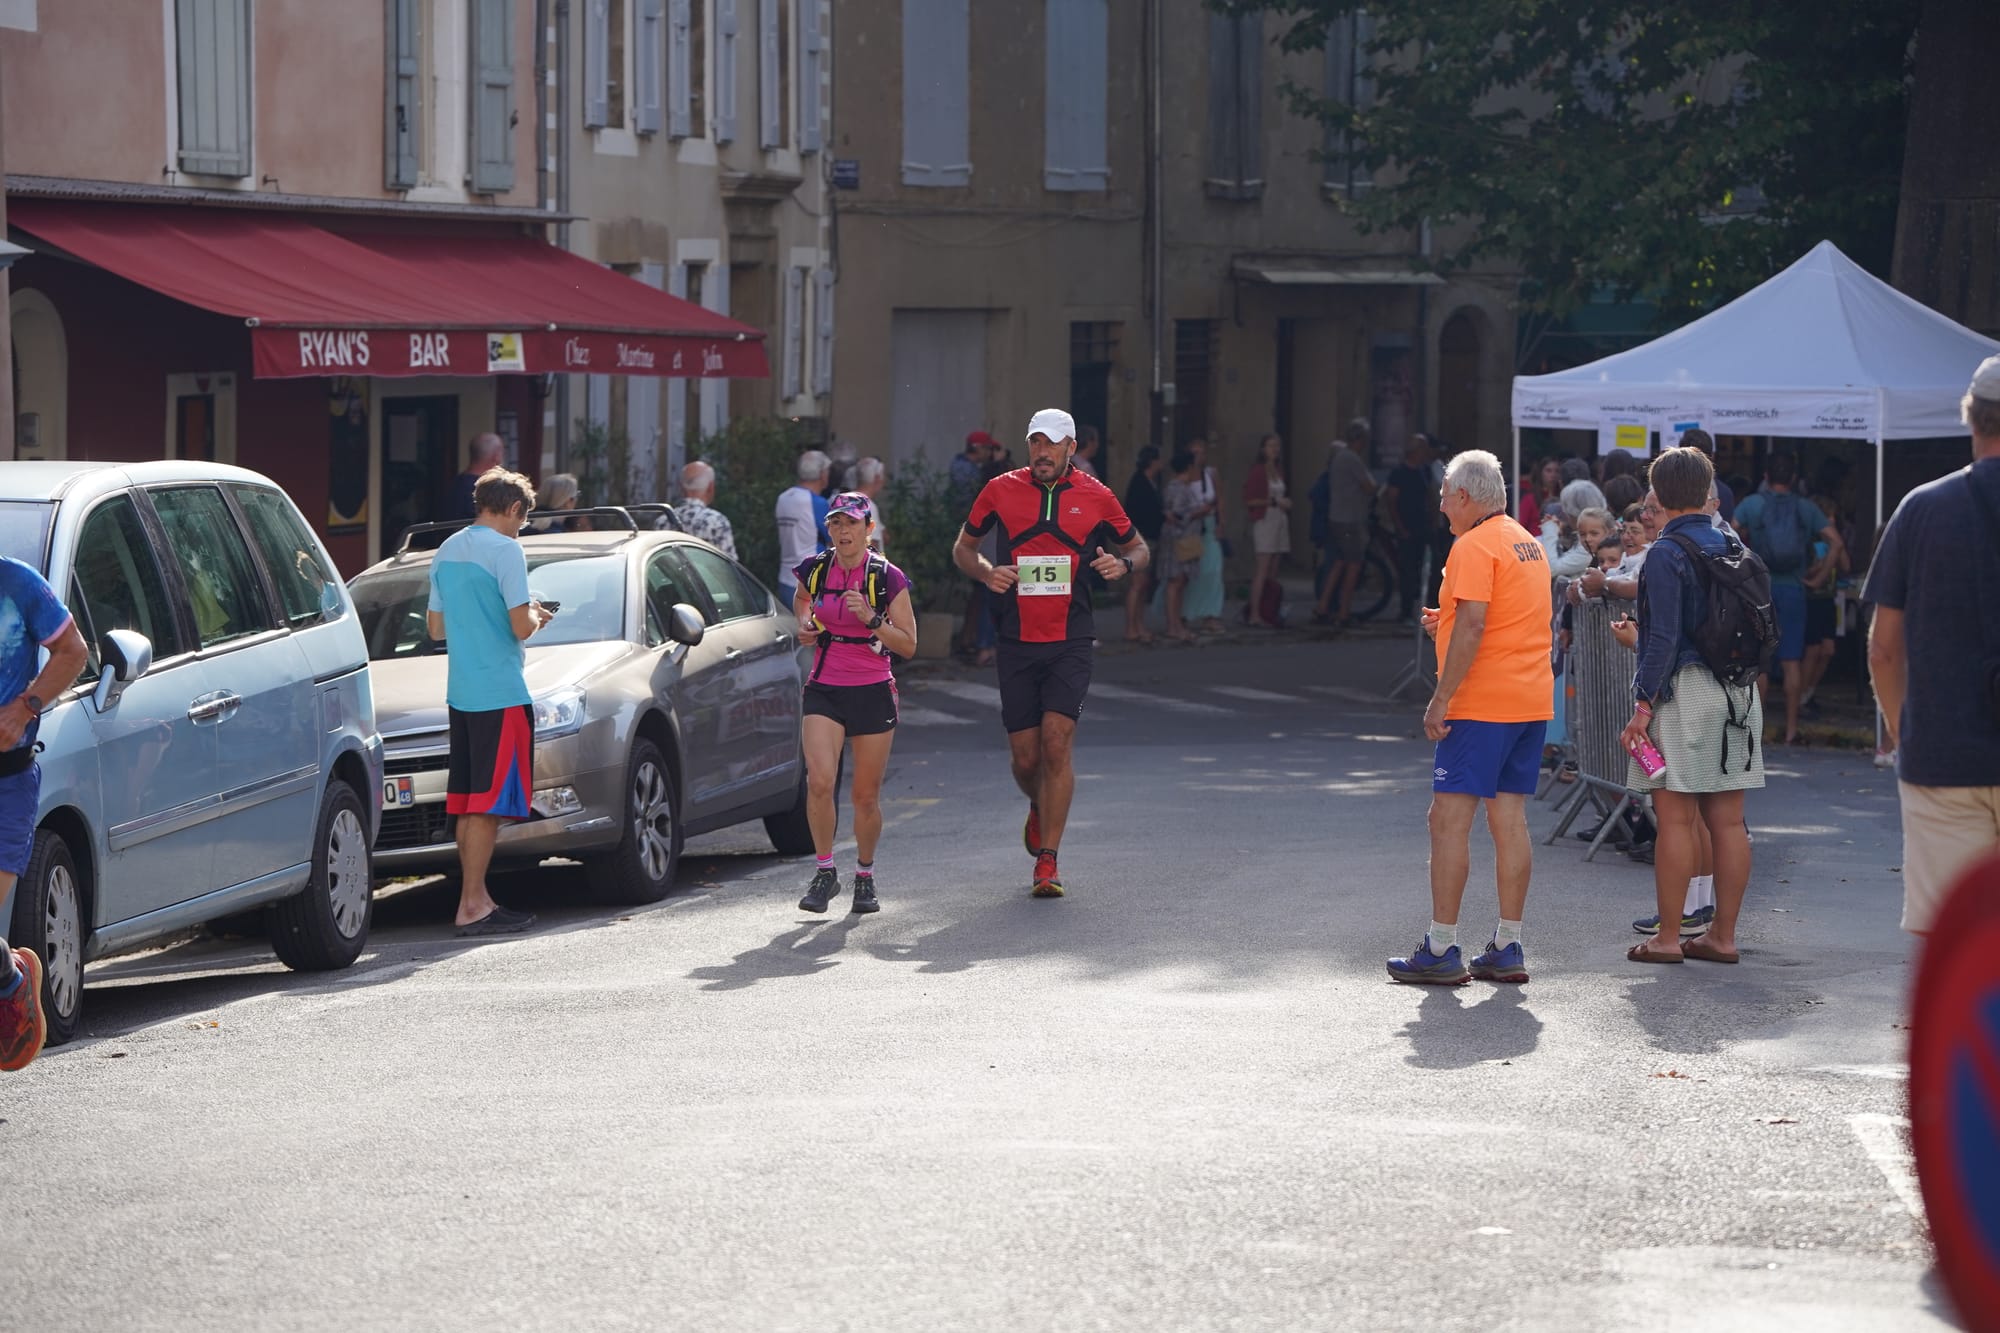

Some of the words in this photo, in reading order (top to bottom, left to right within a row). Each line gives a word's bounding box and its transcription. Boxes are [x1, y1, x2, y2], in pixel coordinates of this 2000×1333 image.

[298, 331, 370, 367] RYAN'S
[409, 333, 450, 367] BAR
[565, 337, 589, 365] Chez
[702, 344, 724, 375] John
[1031, 566, 1057, 582] 15
[400, 791, 411, 802] 48
